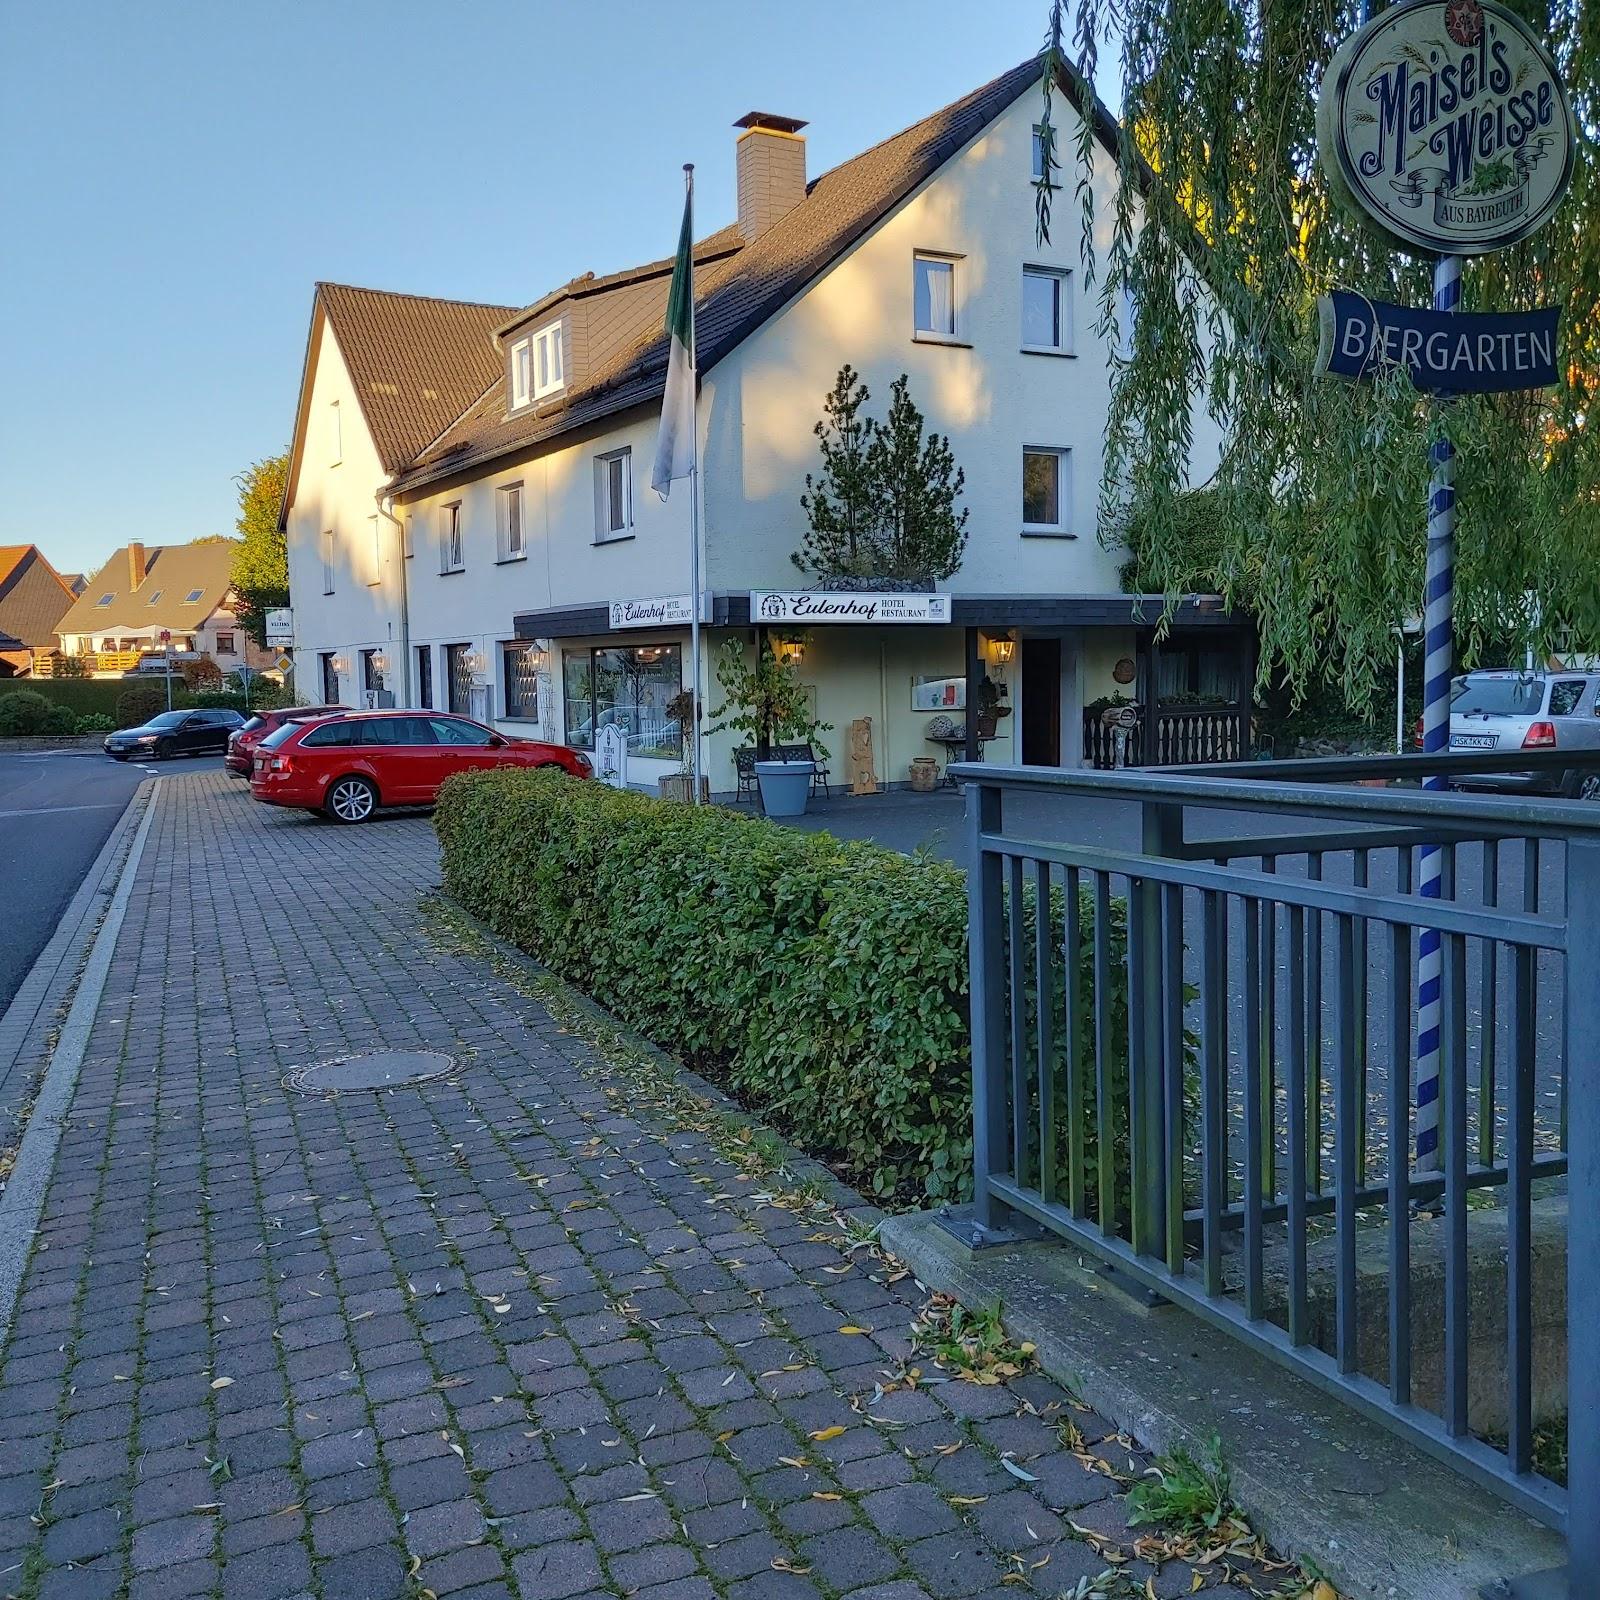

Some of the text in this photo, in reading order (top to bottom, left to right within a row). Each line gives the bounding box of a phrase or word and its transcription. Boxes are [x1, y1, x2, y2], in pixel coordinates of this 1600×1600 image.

[1360, 24, 1512, 178] Maisel's
[1429, 80, 1556, 193] Weisse
[1440, 192, 1524, 225] AUS BAYREUTH
[1341, 317, 1552, 373] BIERGARTEN
[624, 602, 666, 622] Eulenhof
[790, 596, 878, 620] Eulenhof
[881, 599, 906, 608] HOTEL
[881, 609, 927, 618] RESTAURANT
[1454, 736, 1468, 745] HSK
